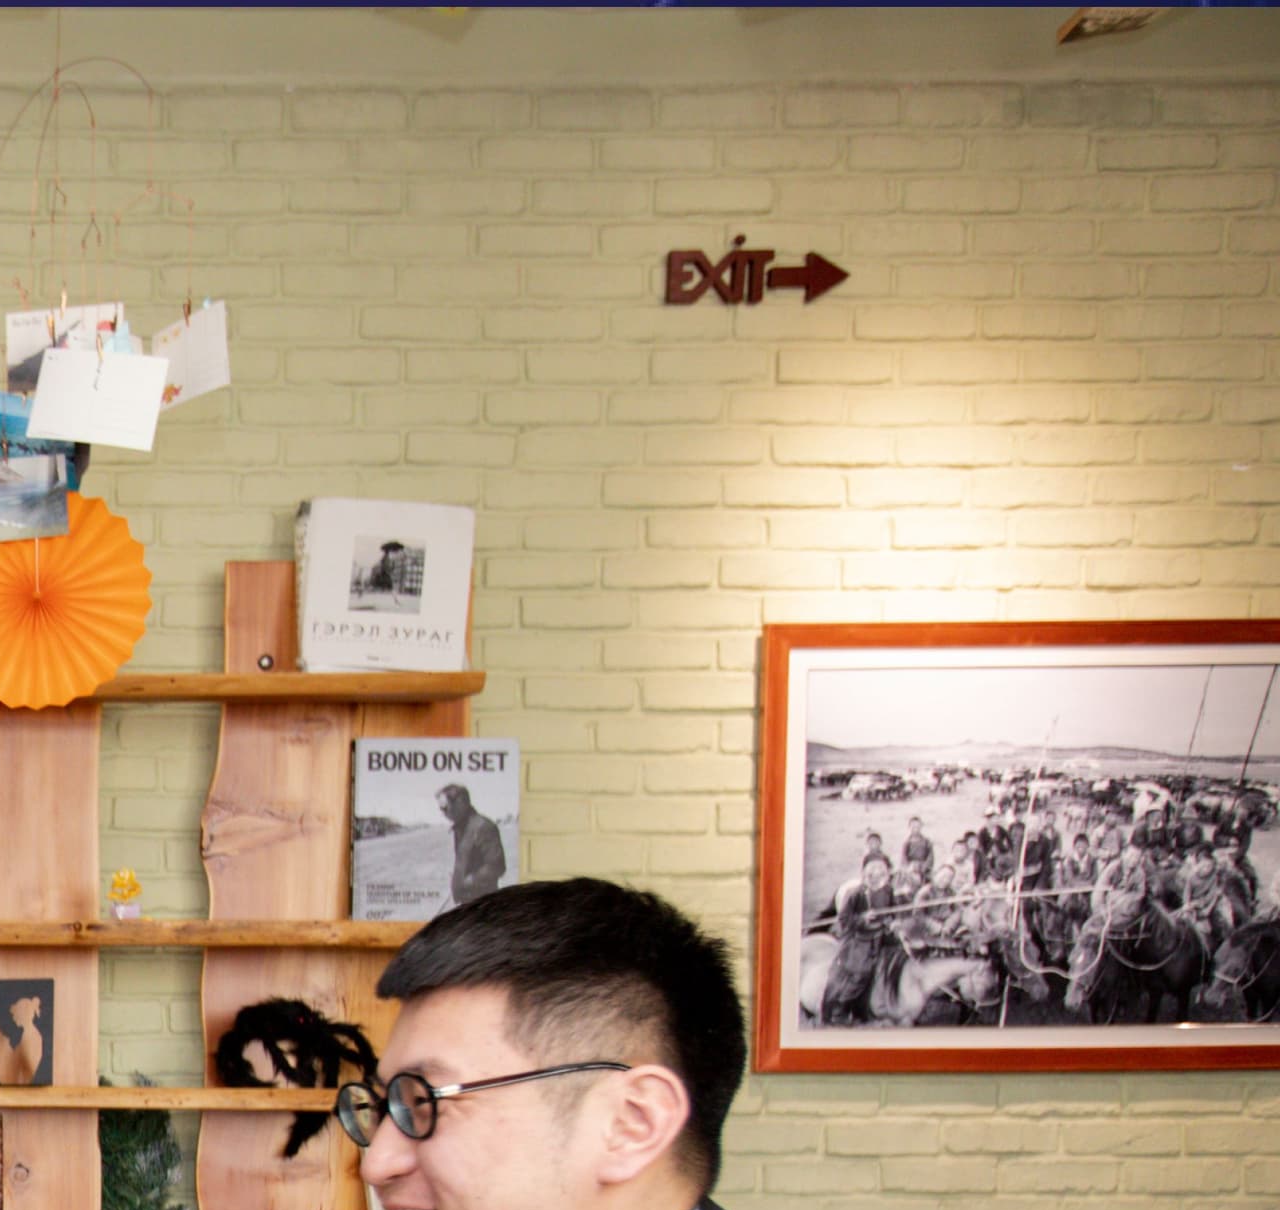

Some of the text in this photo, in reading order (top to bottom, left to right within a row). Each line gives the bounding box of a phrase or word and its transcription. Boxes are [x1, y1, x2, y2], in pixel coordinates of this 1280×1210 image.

[367, 751, 508, 772] BOND ON SET
